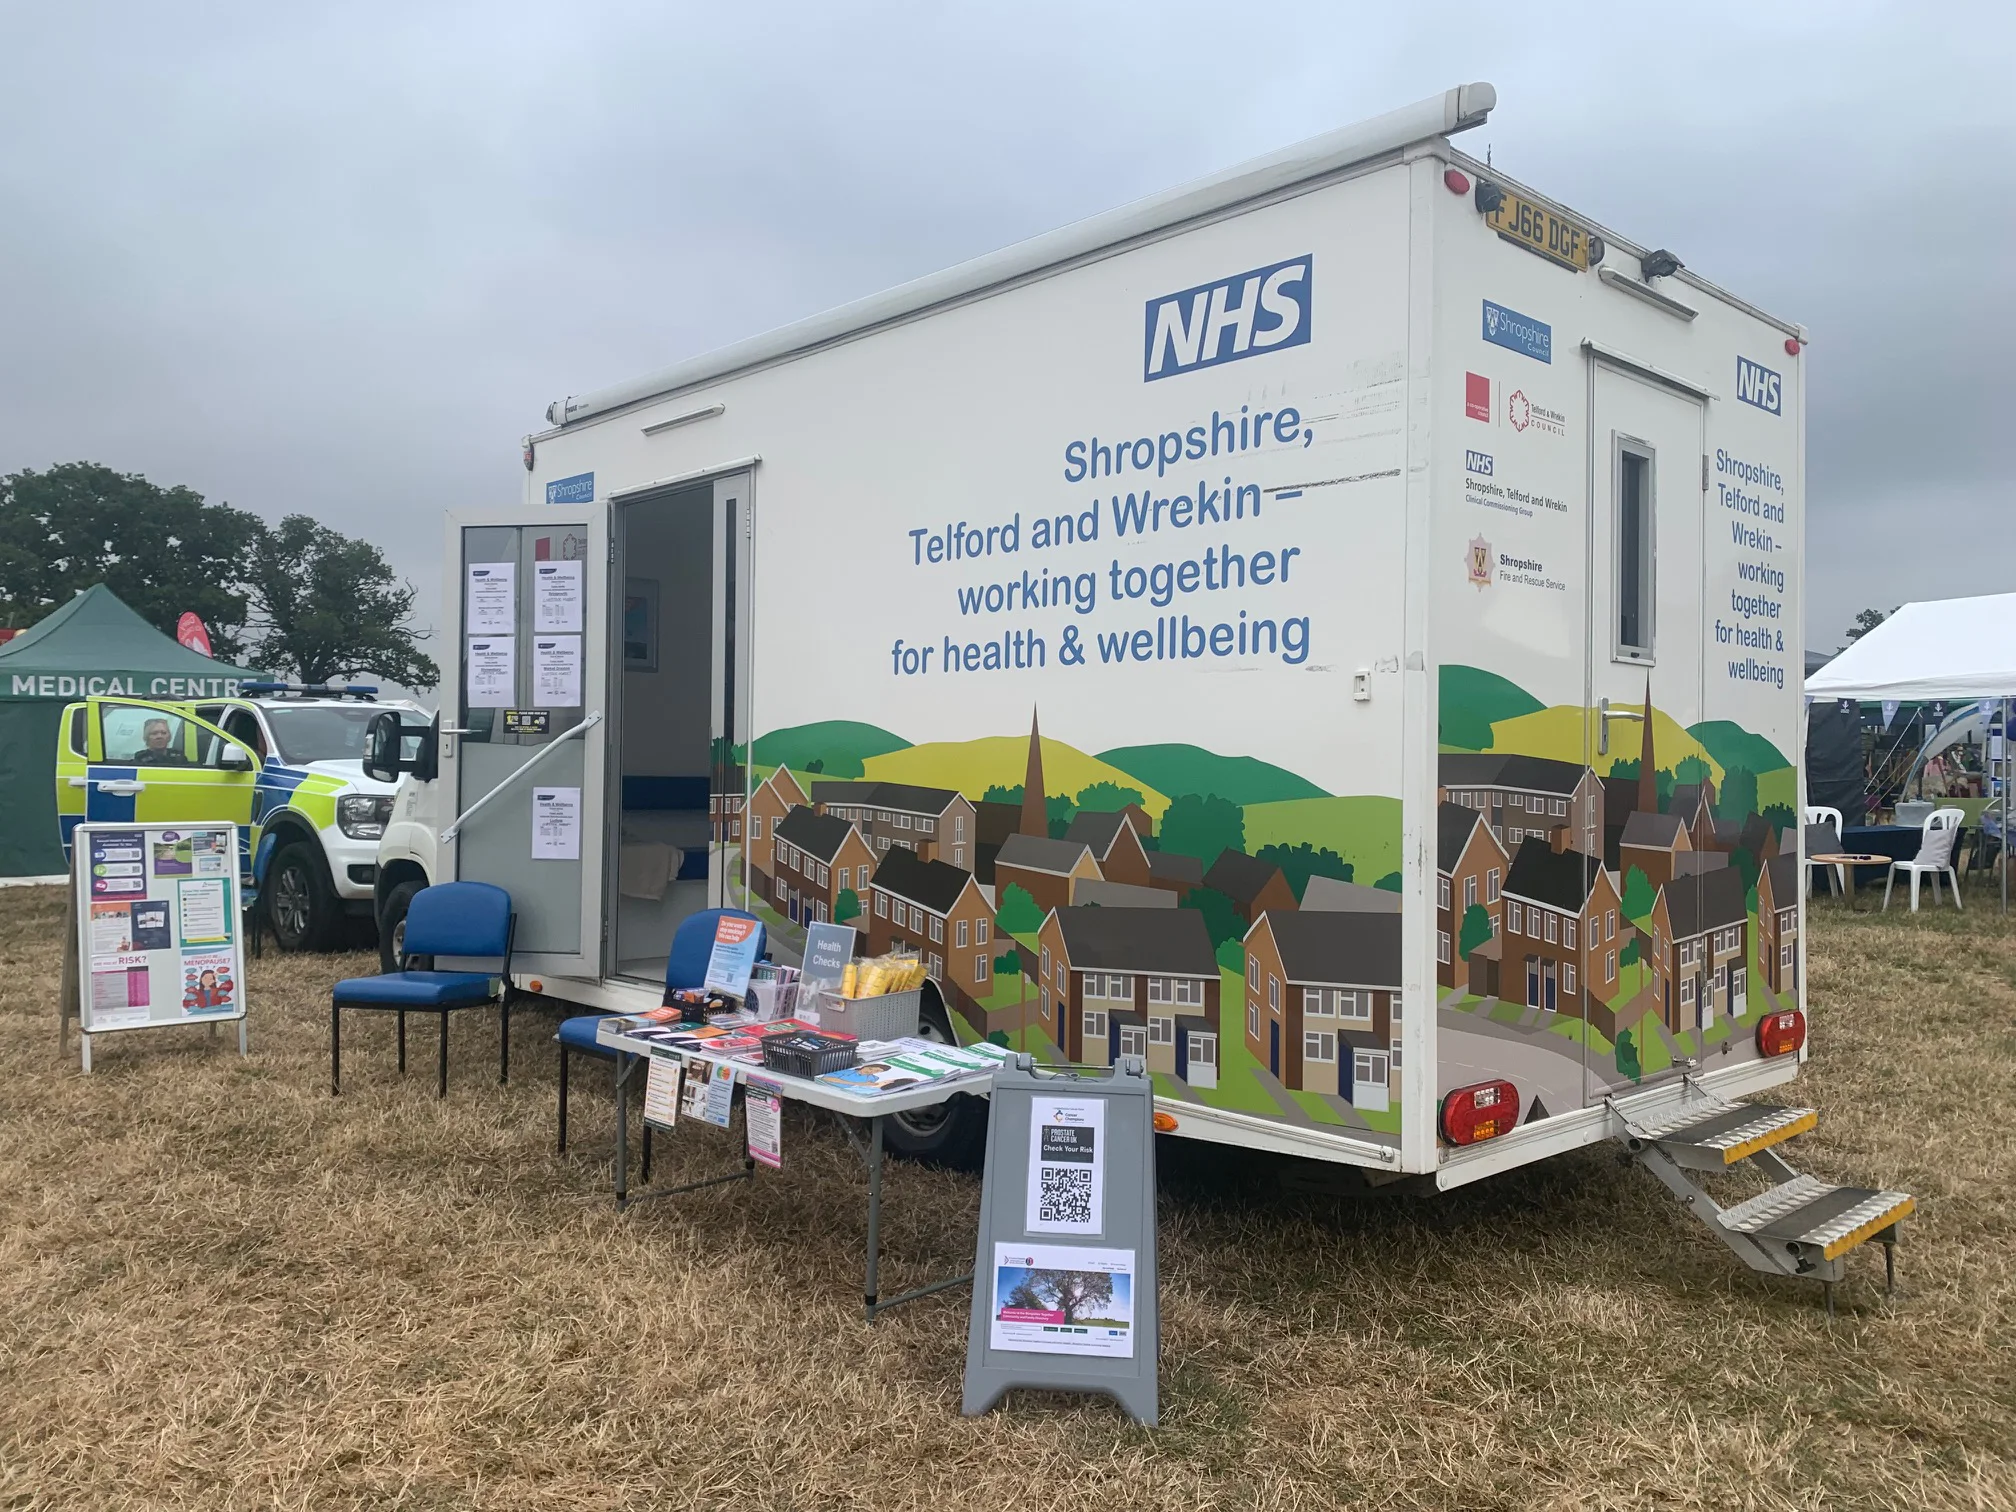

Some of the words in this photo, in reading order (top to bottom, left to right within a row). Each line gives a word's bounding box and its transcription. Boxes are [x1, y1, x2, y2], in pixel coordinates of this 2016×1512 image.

[1549, 217, 1581, 260] DGF
[1148, 264, 1307, 375] NHS
[1500, 312, 1549, 348] Shropshire
[1527, 343, 1549, 358] Council
[1738, 360, 1780, 411] NHS
[1531, 403, 1546, 417] Telford
[1550, 411, 1566, 422] Wrekin
[1531, 419, 1565, 437] COUNCIL
[1064, 405, 1314, 484] Shropshire,
[1466, 451, 1492, 475] NHS
[1716, 448, 1784, 496] Shropshire,
[557, 478, 592, 498] Shropshire
[575, 491, 592, 500] Council
[1465, 478, 1505, 499] Shropshire,
[1506, 488, 1530, 504] Telford
[1531, 495, 1544, 507] and
[1545, 497, 1568, 513] Wrekin
[1465, 494, 1483, 505] Clinical
[1483, 498, 1519, 516] Commissioning
[1518, 506, 1533, 518] Group
[1717, 482, 1760, 517] Telford
[1763, 502, 1784, 524] and
[909, 512, 1020, 566] Telford
[1031, 499, 1100, 549] and
[1112, 476, 1261, 537] Wrekin
[1732, 520, 1773, 553] Wrekin
[1500, 553, 1543, 572] Shropshire
[958, 568, 1096, 615] working
[1109, 543, 1301, 607] together
[1500, 570, 1511, 581] Fire
[1512, 573, 1523, 584] and
[1524, 575, 1545, 588] Rescue
[1546, 578, 1566, 591] Service
[1738, 561, 1784, 593] working
[1732, 588, 1781, 620] together
[892, 638, 935, 676] for
[943, 628, 1046, 673] health
[1058, 624, 1087, 666] &
[1097, 610, 1310, 665] wellbeing
[1715, 618, 1733, 644] for
[1736, 622, 1772, 650] health
[1775, 629, 1784, 652] &
[12, 674, 143, 697] MEDICAL
[150, 678, 257, 697] CENTR
[1728, 657, 1784, 690] wellbeing
[817, 940, 841, 953] Health
[118, 955, 147, 965] RISK?
[183, 957, 231, 967] MENOPAUSE?
[812, 954, 840, 969] Checks
[1051, 1128, 1075, 1136] PROSTATE
[1051, 1135, 1070, 1143] CANCER
[1043, 1144, 1063, 1152] Check
